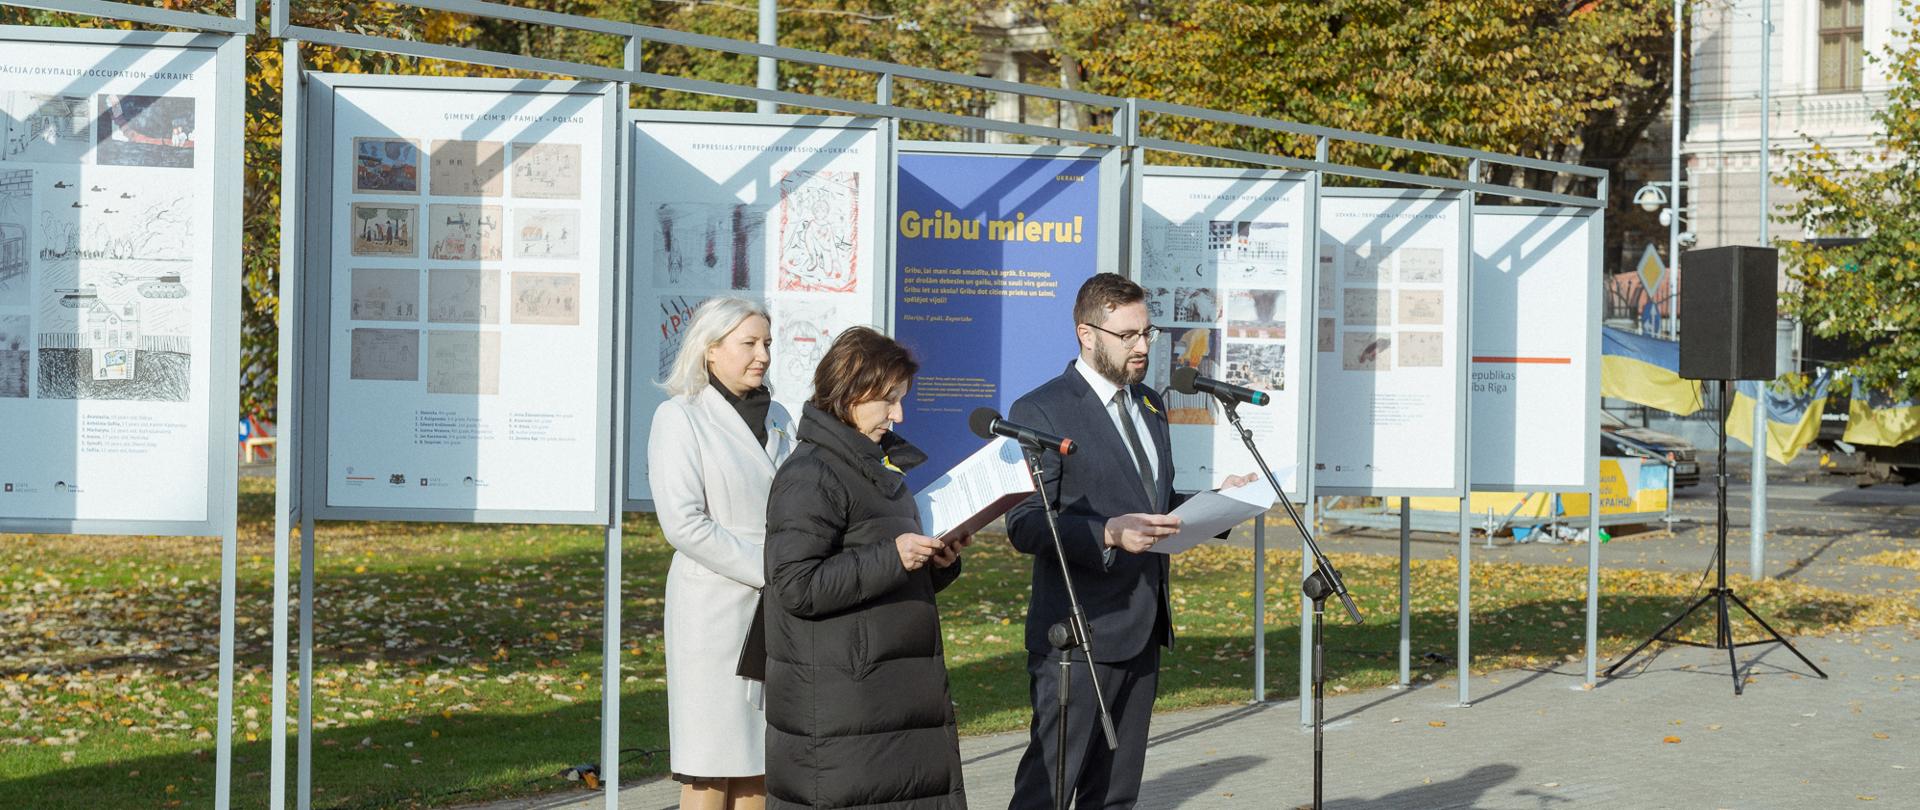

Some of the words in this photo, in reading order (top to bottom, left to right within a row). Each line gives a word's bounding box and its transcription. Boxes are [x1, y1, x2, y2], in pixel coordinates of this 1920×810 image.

[154, 72, 194, 80] UKRAINE
[900, 209, 980, 240] Gribu
[988, 212, 1082, 244] mieru!
[1472, 370, 1516, 382] epublikas
